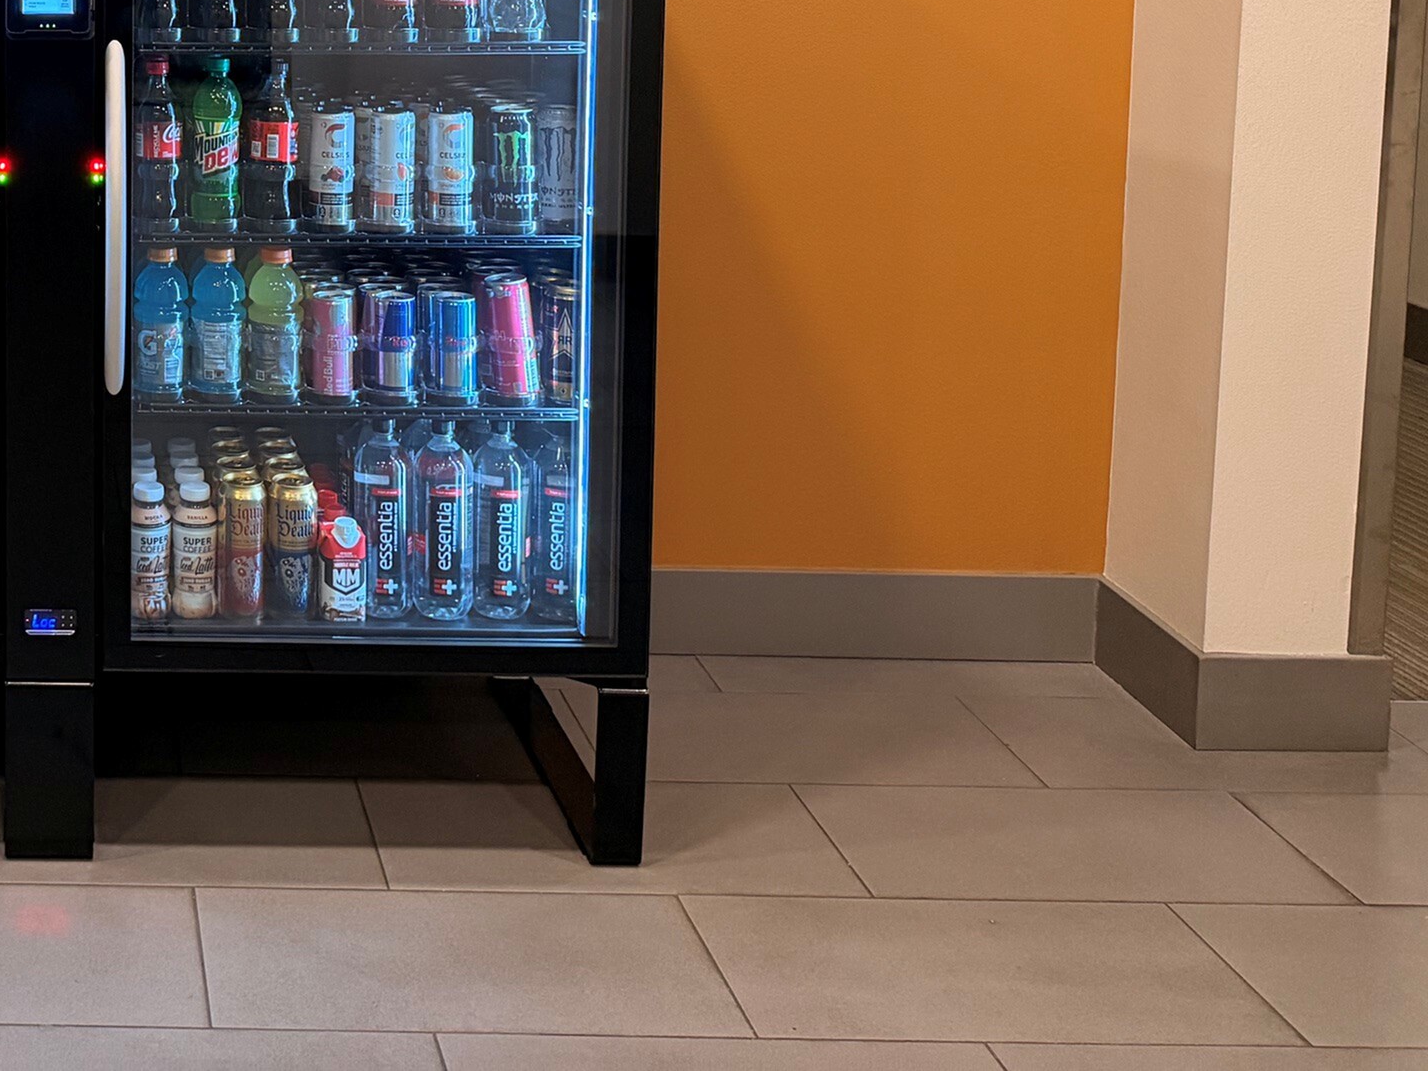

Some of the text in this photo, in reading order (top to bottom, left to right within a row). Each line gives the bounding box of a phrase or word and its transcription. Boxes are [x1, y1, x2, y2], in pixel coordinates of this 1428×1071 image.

[137, 329, 157, 356] G
[322, 356, 333, 375] Bull
[275, 501, 313, 525] Liquid
[140, 534, 169, 545] SUPER
[183, 536, 212, 546] SUPER
[377, 501, 394, 571] essentia
[436, 502, 453, 571] essentia
[496, 502, 514, 573] essentia
[548, 501, 566, 571] essentia
[183, 545, 212, 554] COFFEE
